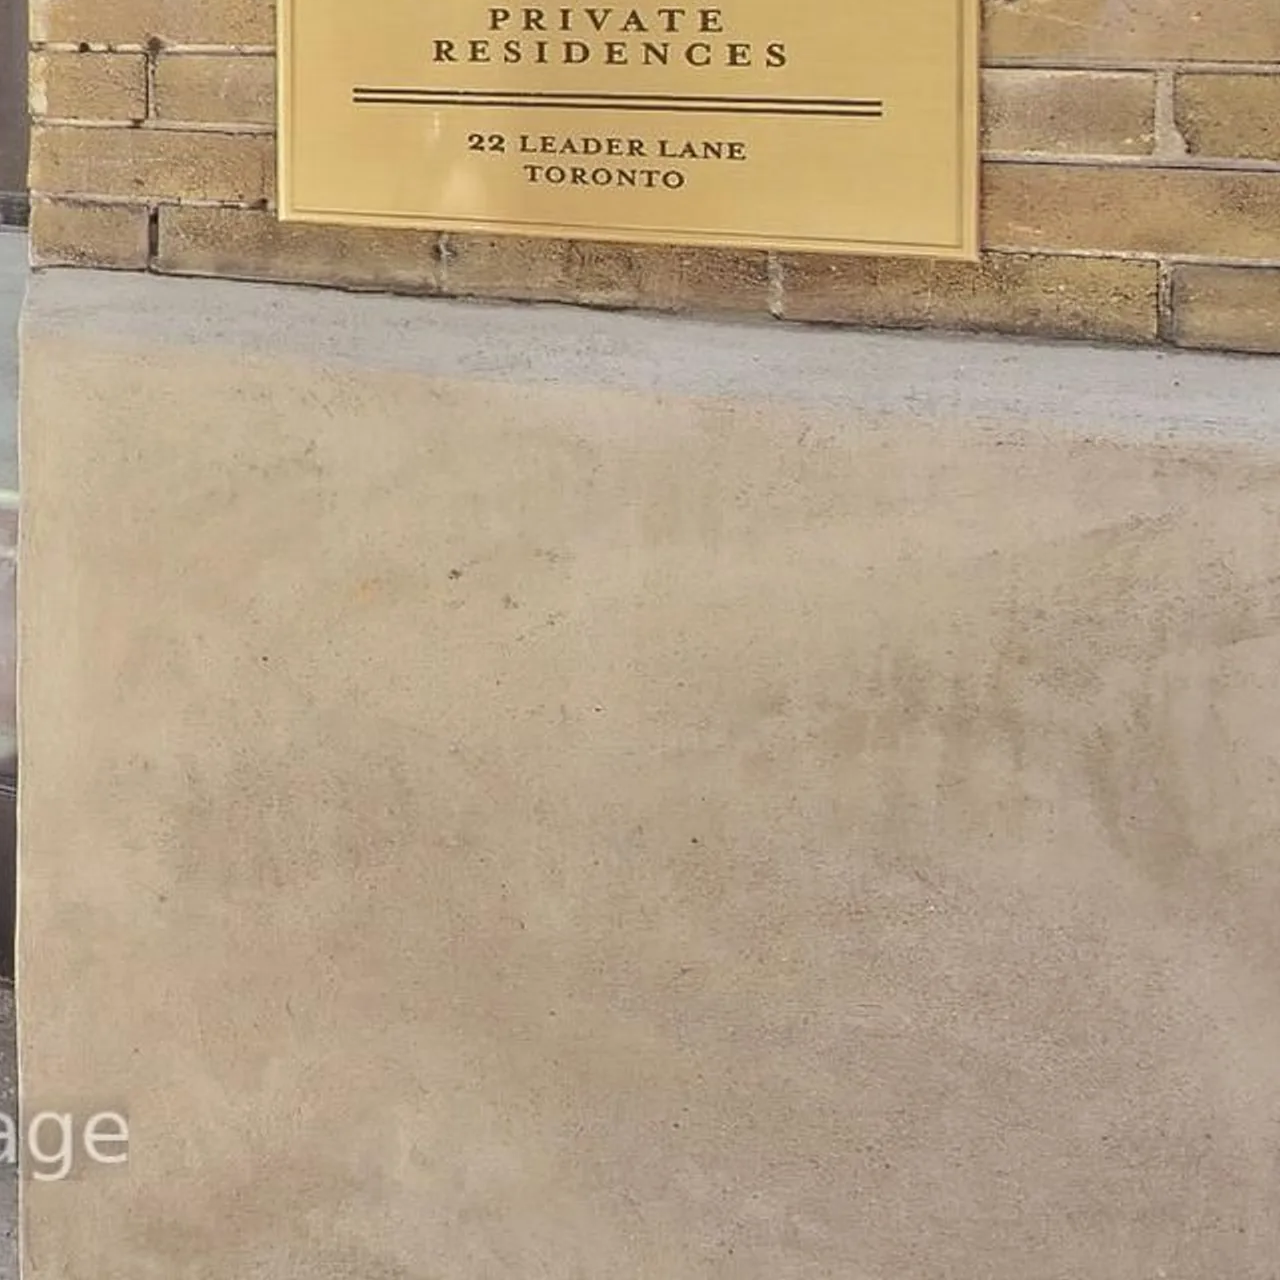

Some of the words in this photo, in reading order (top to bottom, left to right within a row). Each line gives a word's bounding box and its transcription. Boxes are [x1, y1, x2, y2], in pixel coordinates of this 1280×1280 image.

[489, 7, 725, 34] PRIVATE
[432, 39, 790, 68] RESIDENCES
[466, 133, 507, 154] 22
[519, 134, 647, 158] LEADER
[658, 138, 748, 162] LANE
[524, 164, 686, 191] TORONTO
